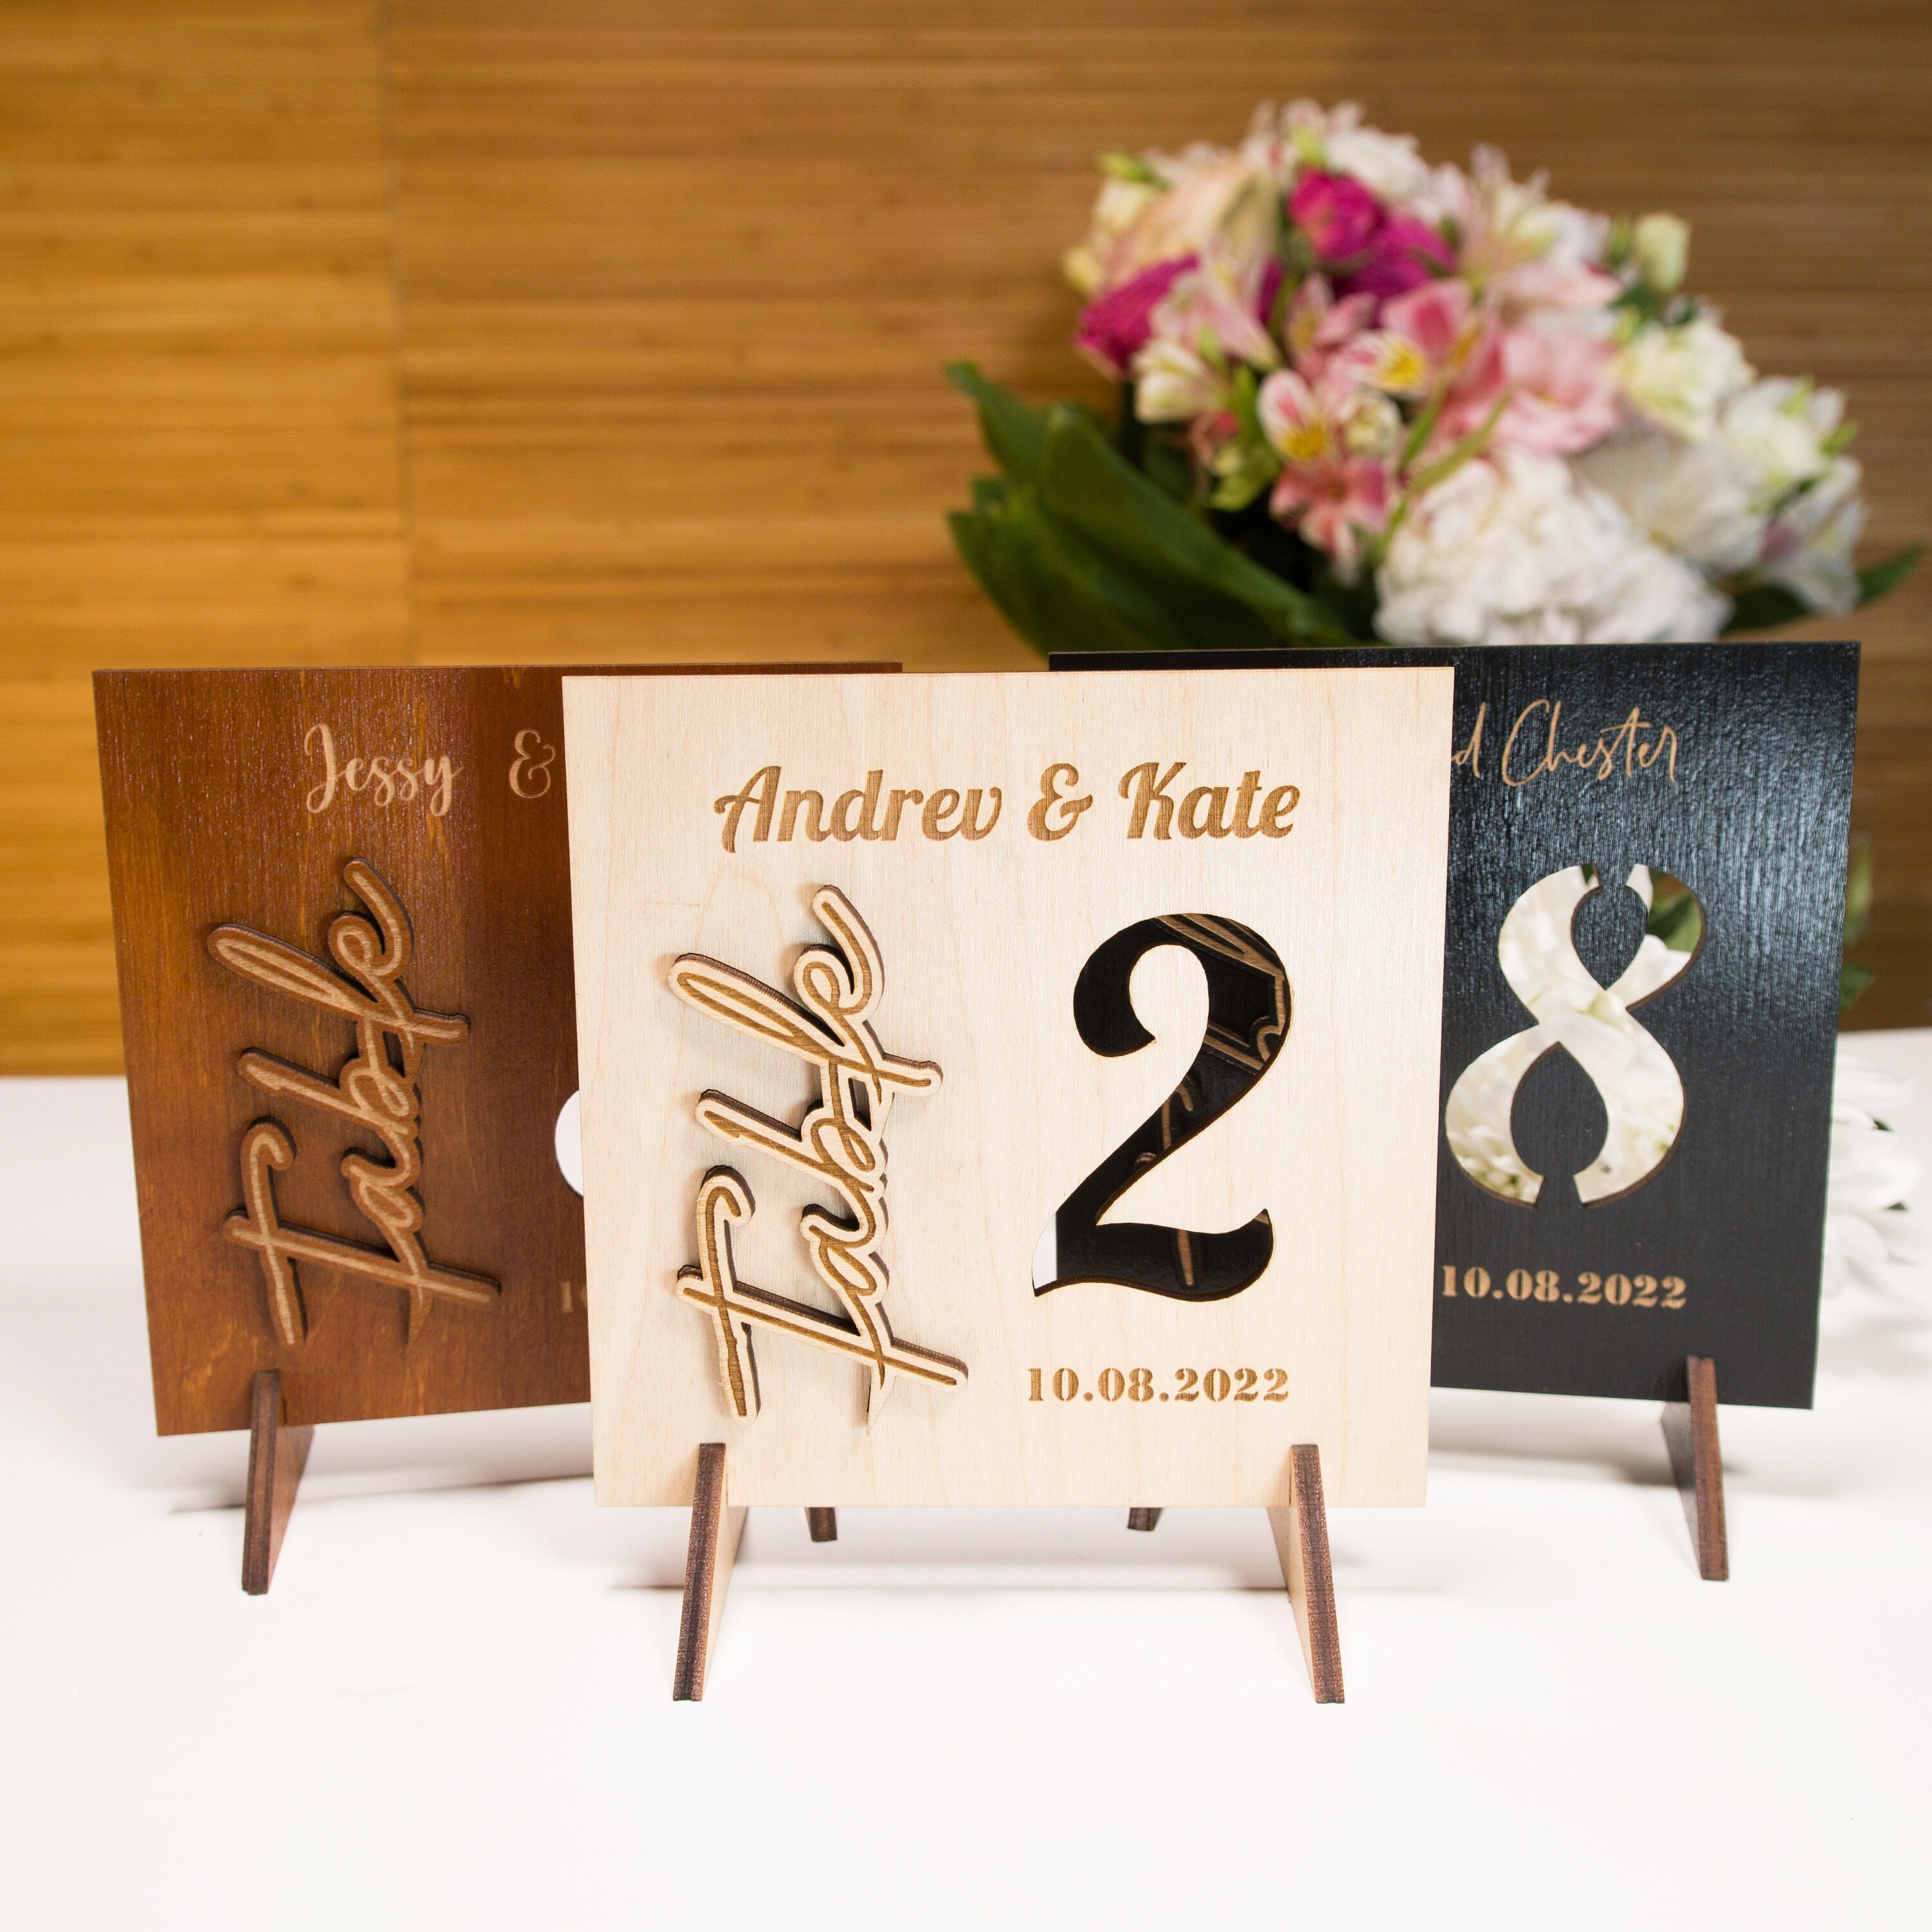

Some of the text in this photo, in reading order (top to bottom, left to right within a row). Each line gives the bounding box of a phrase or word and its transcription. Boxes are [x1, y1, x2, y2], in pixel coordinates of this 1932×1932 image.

[304, 723, 556, 817] Jessy &
[1502, 698, 1678, 787] Chester
[714, 761, 1301, 853] Andrev & Kate
[1445, 863, 1705, 1209] 8
[209, 859, 500, 1347] Table
[1032, 913, 1291, 1302] 2
[668, 885, 968, 1431] Table
[1442, 1265, 1686, 1309] 10.08.2022
[1028, 1367, 1289, 1403] 10.08.2022
